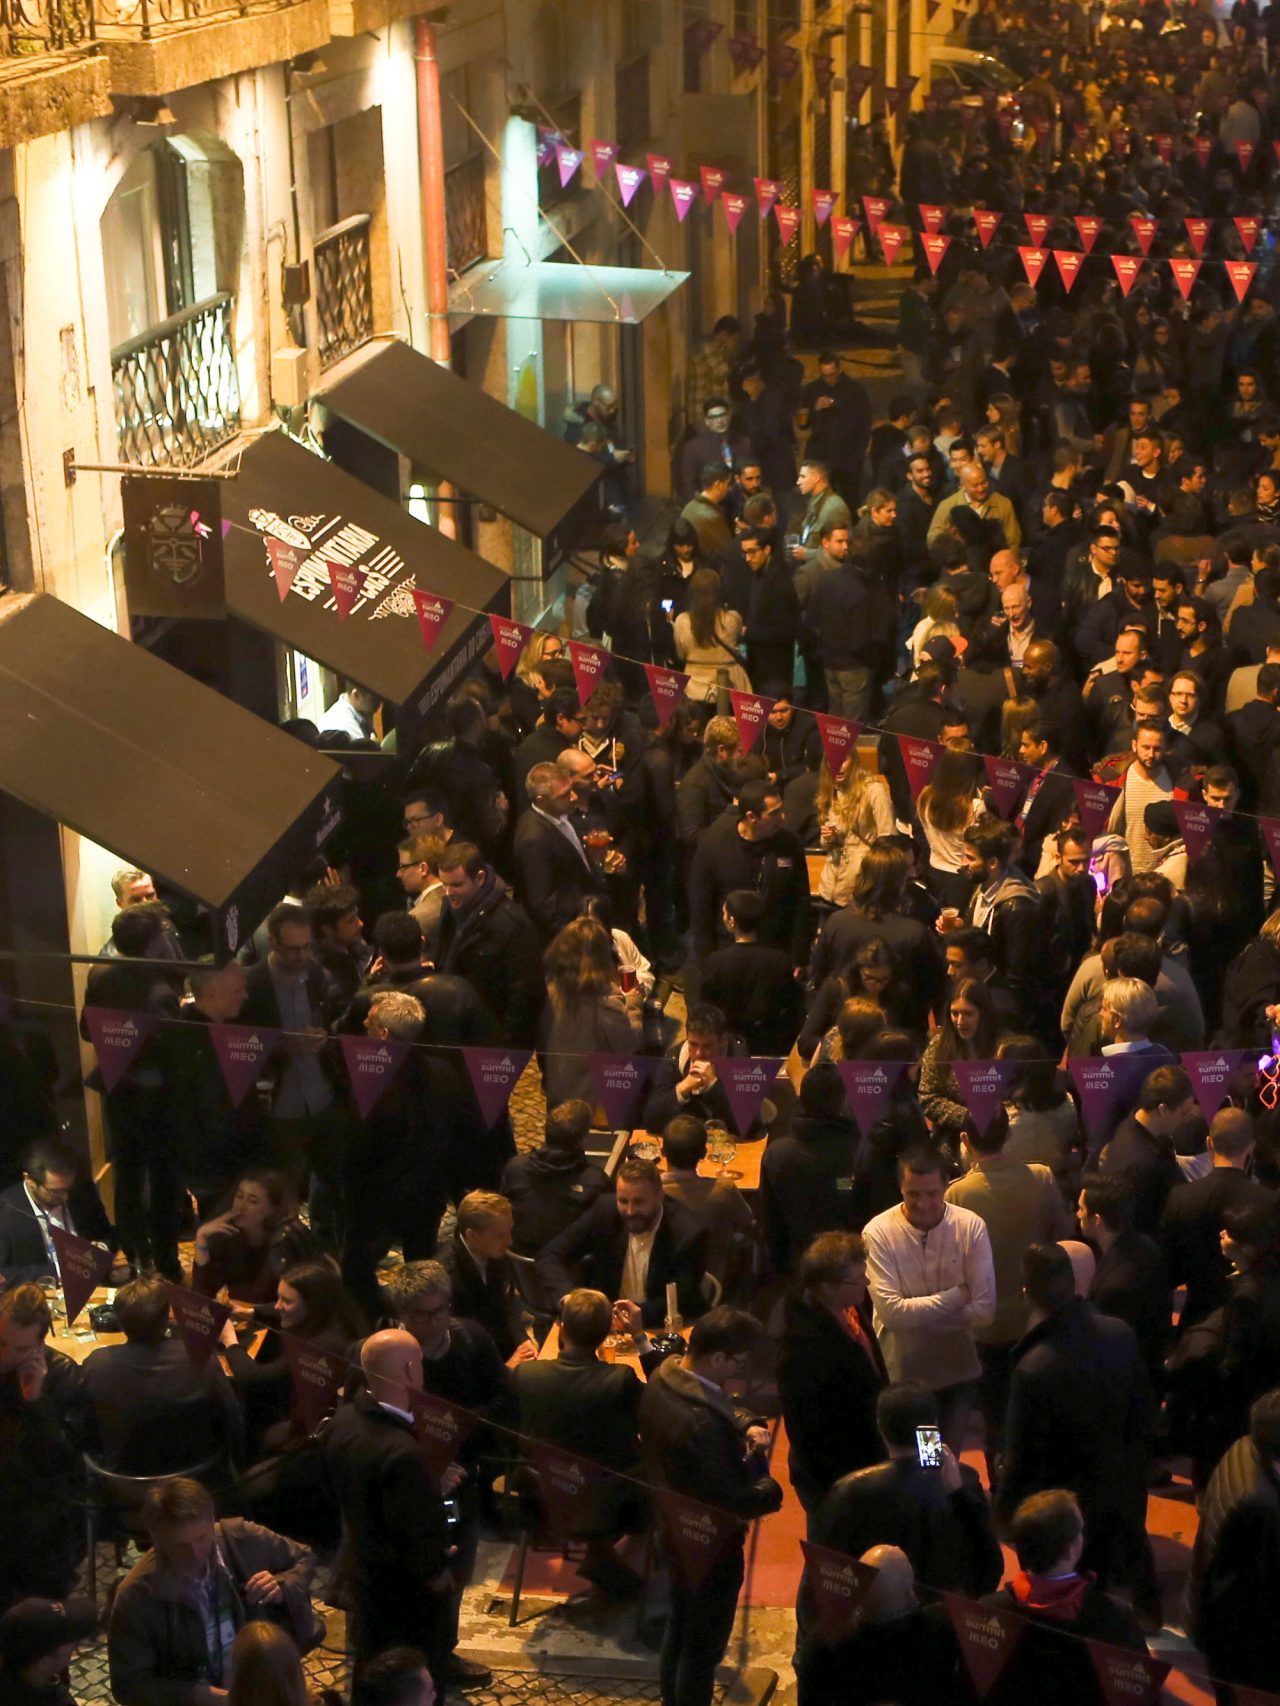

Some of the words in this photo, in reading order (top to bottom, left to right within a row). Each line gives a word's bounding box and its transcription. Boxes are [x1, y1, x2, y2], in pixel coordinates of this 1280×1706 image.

[102, 1026, 138, 1036] summit
[228, 1042, 264, 1050] summit
[356, 1054, 392, 1064] summit
[481, 1064, 515, 1073] summit
[1198, 1064, 1229, 1073] summit
[604, 1070, 638, 1079] summit
[733, 1073, 766, 1081] summit
[970, 1074, 1002, 1082] summit
[1083, 1071, 1114, 1080] summit
